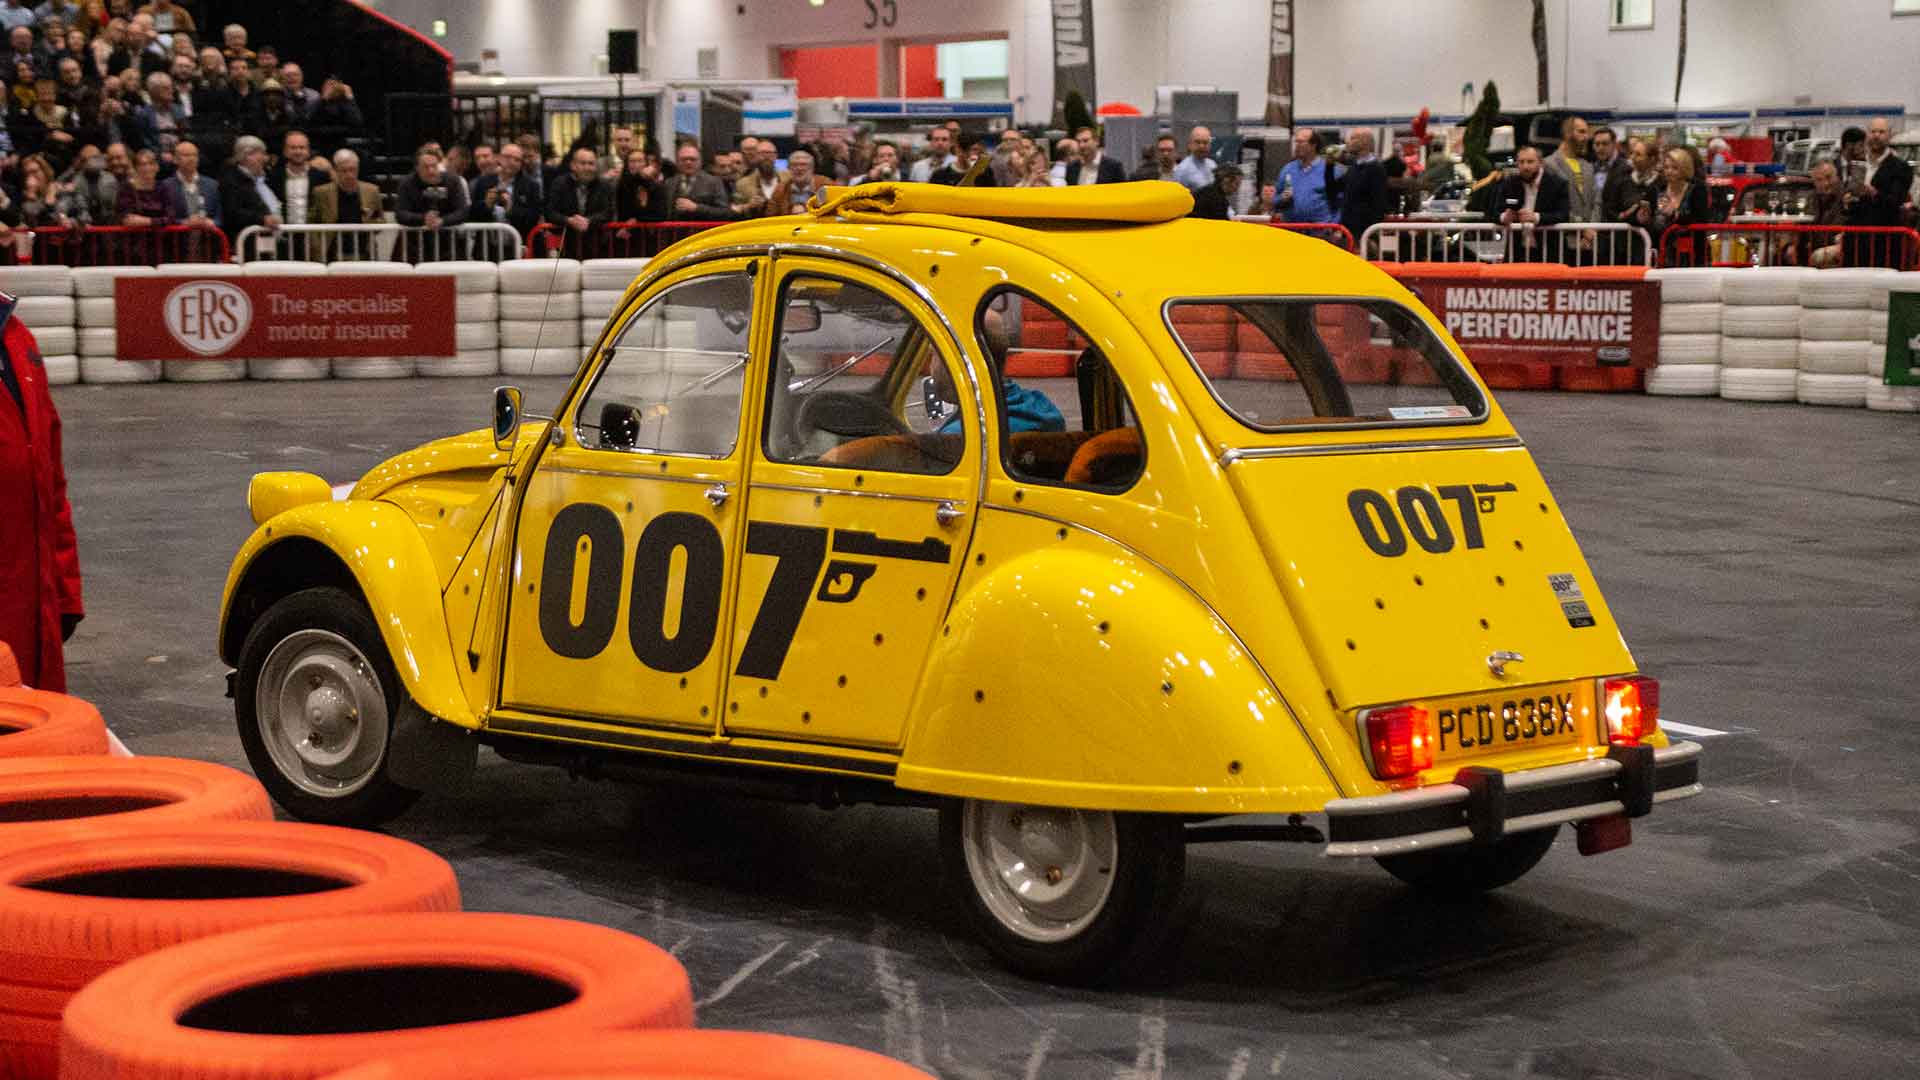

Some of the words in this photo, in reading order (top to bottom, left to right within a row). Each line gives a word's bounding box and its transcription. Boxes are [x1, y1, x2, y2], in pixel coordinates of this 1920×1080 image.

[179, 288, 239, 340] ERS
[267, 293, 305, 314] The
[312, 292, 409, 318] specialist
[1446, 287, 1549, 311] MAXIMISE
[1555, 289, 1632, 312] ENGINE
[267, 323, 331, 341] motor
[335, 322, 411, 340] insurer
[1446, 312, 1633, 341] PERFORMANCE
[1347, 484, 1485, 557] 007
[539, 503, 829, 681] 007
[1438, 703, 1494, 751] PCD
[1502, 692, 1575, 742] 838X
